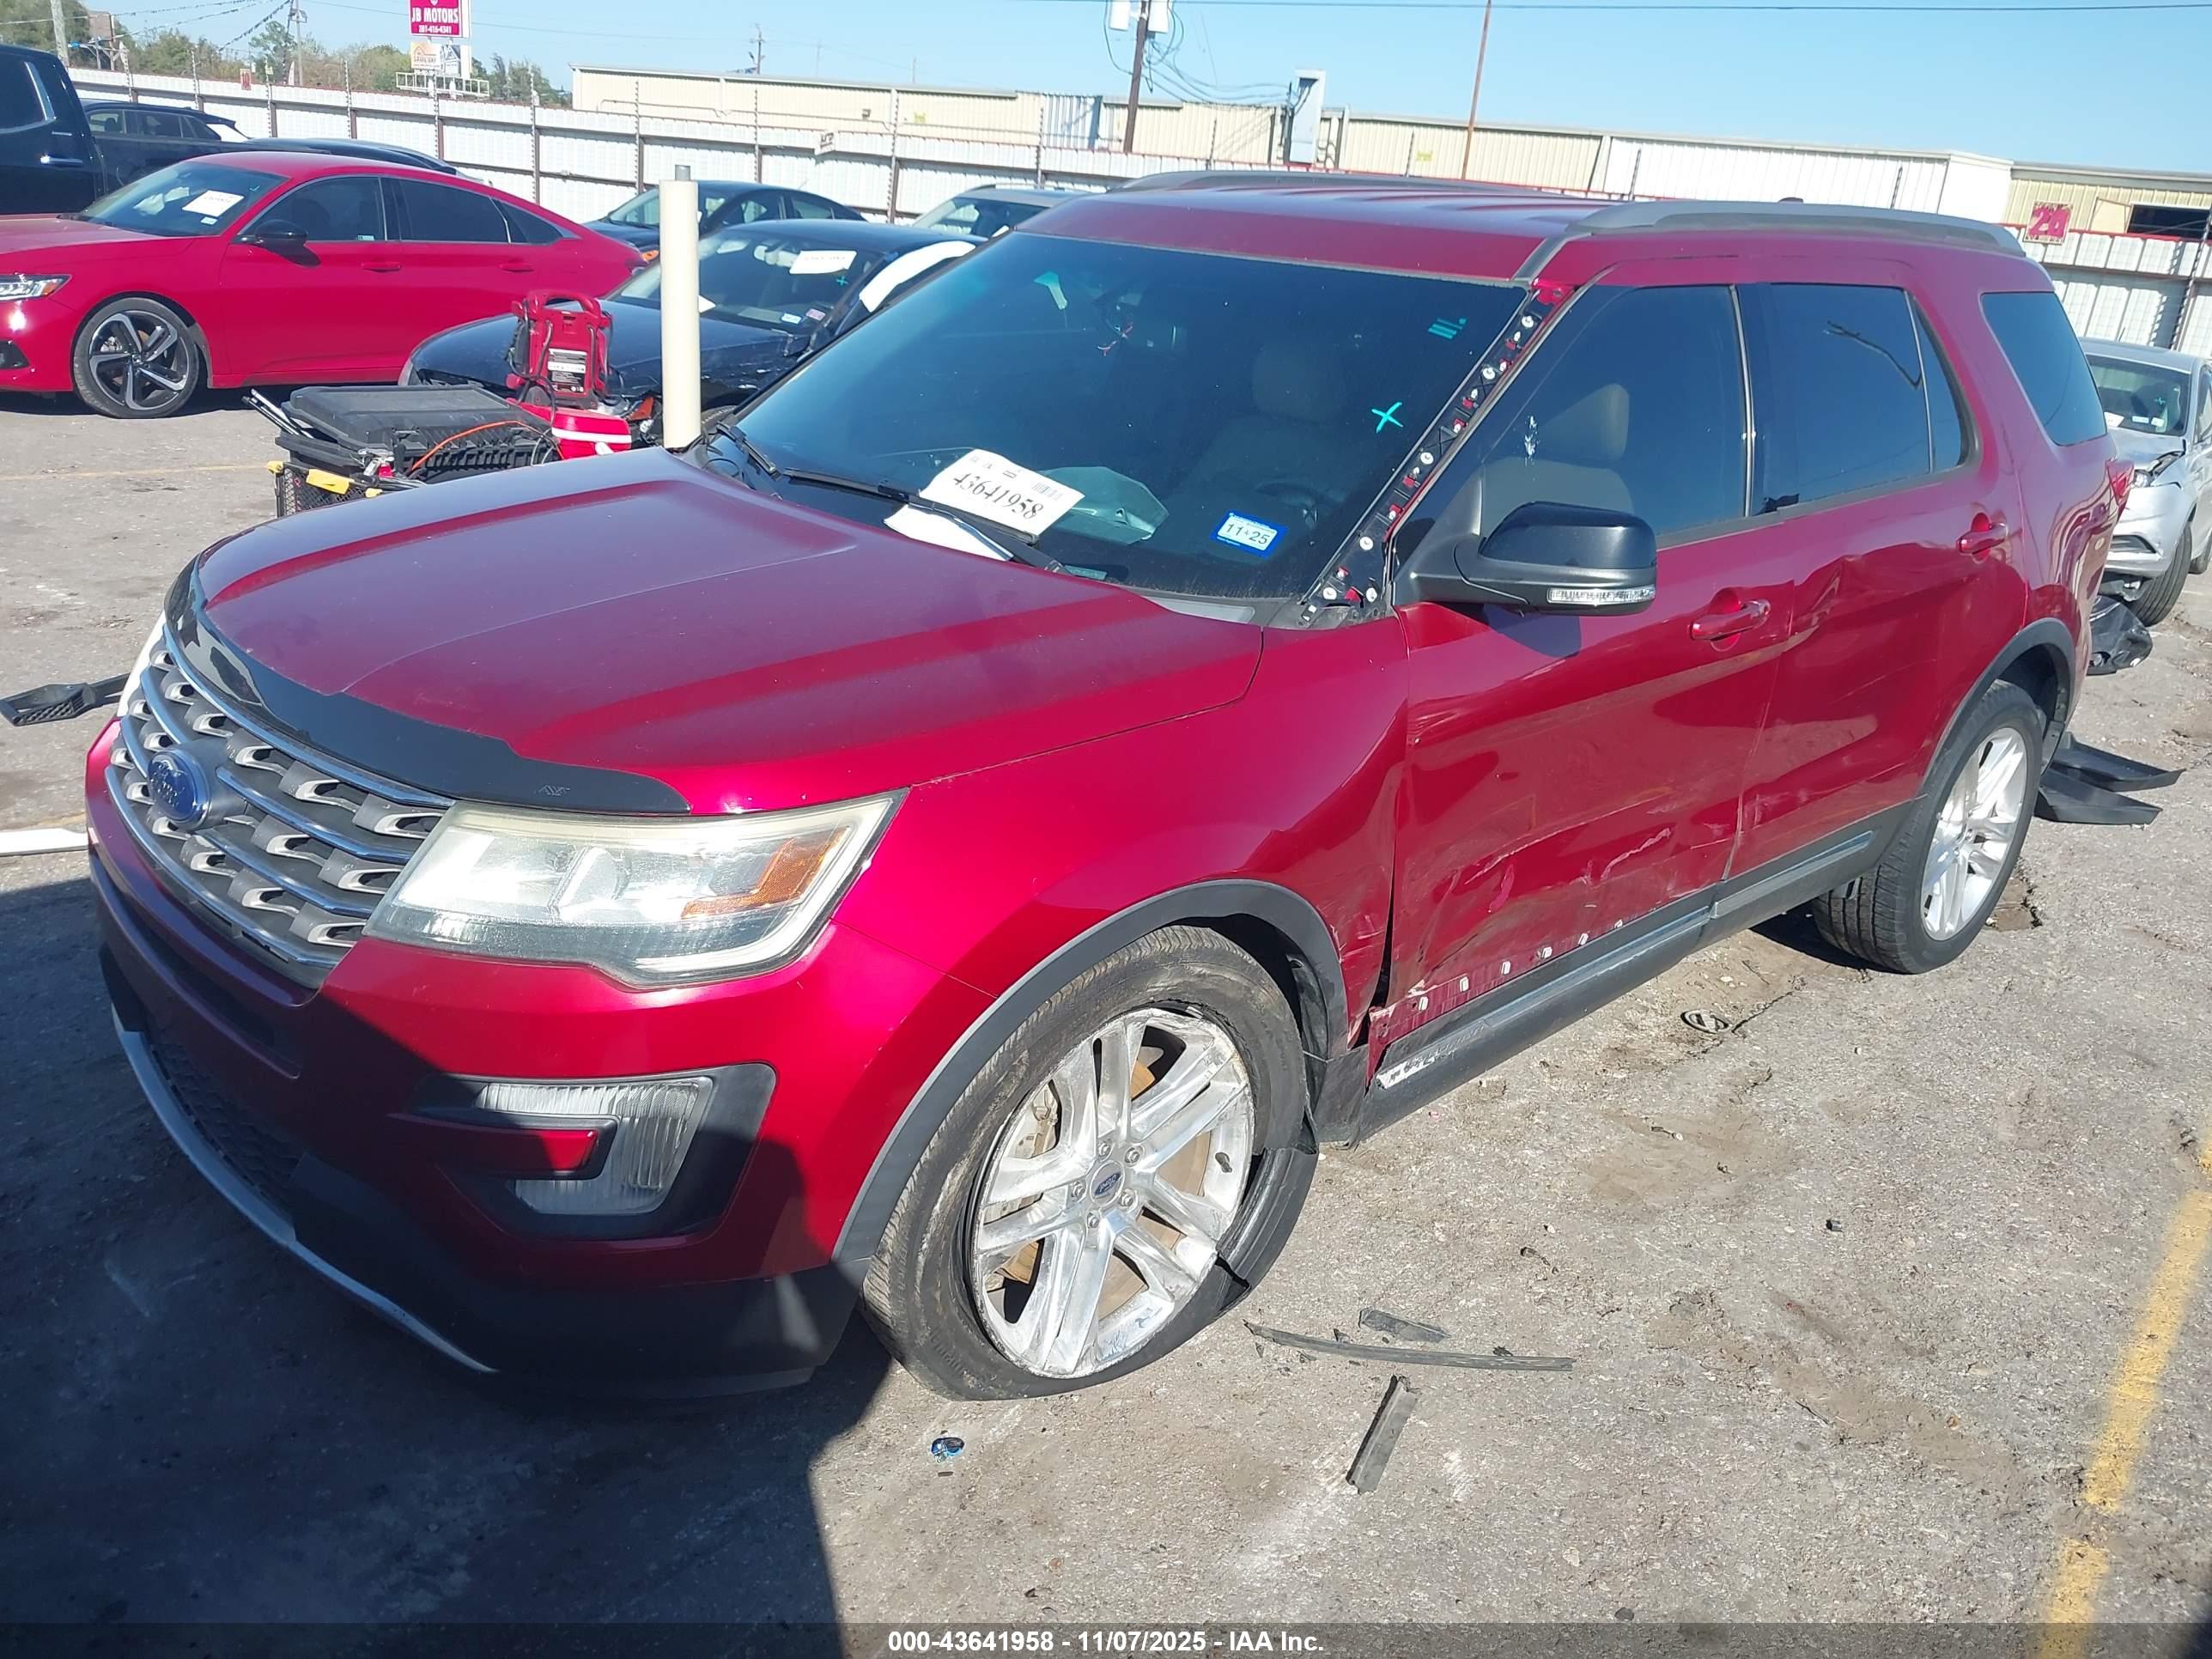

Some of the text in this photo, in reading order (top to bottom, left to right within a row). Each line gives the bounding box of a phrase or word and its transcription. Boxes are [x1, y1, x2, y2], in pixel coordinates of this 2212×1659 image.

[412, 7, 459, 23] JB MOTORS
[953, 472, 1043, 520] 43641958
